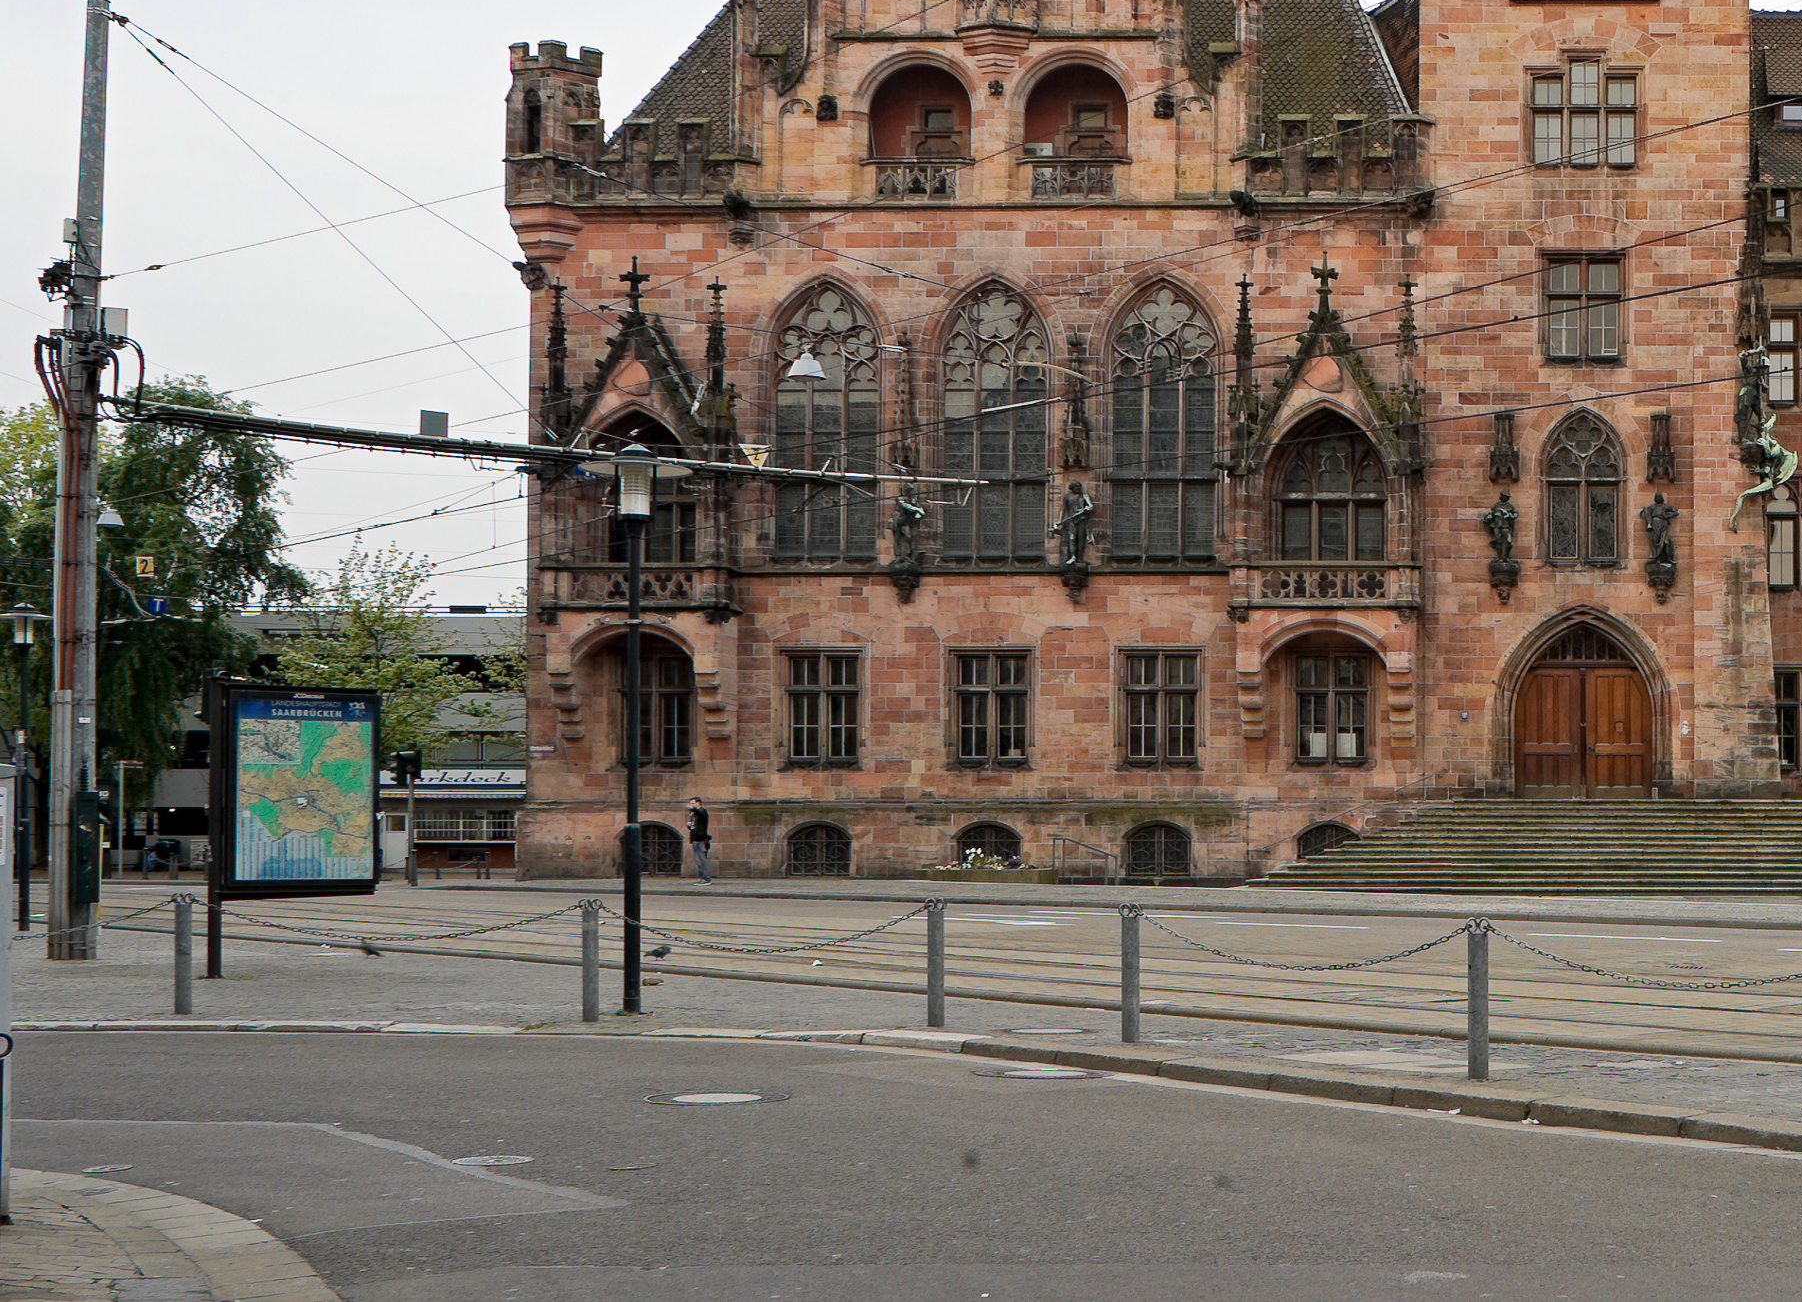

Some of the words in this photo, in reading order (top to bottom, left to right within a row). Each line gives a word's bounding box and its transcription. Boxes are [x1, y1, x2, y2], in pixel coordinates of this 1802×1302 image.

[140, 559, 149, 574] 2
[153, 599, 164, 612] T
[271, 708, 342, 718] SAARBRÜCKEN
[412, 771, 511, 784] arkdeck
